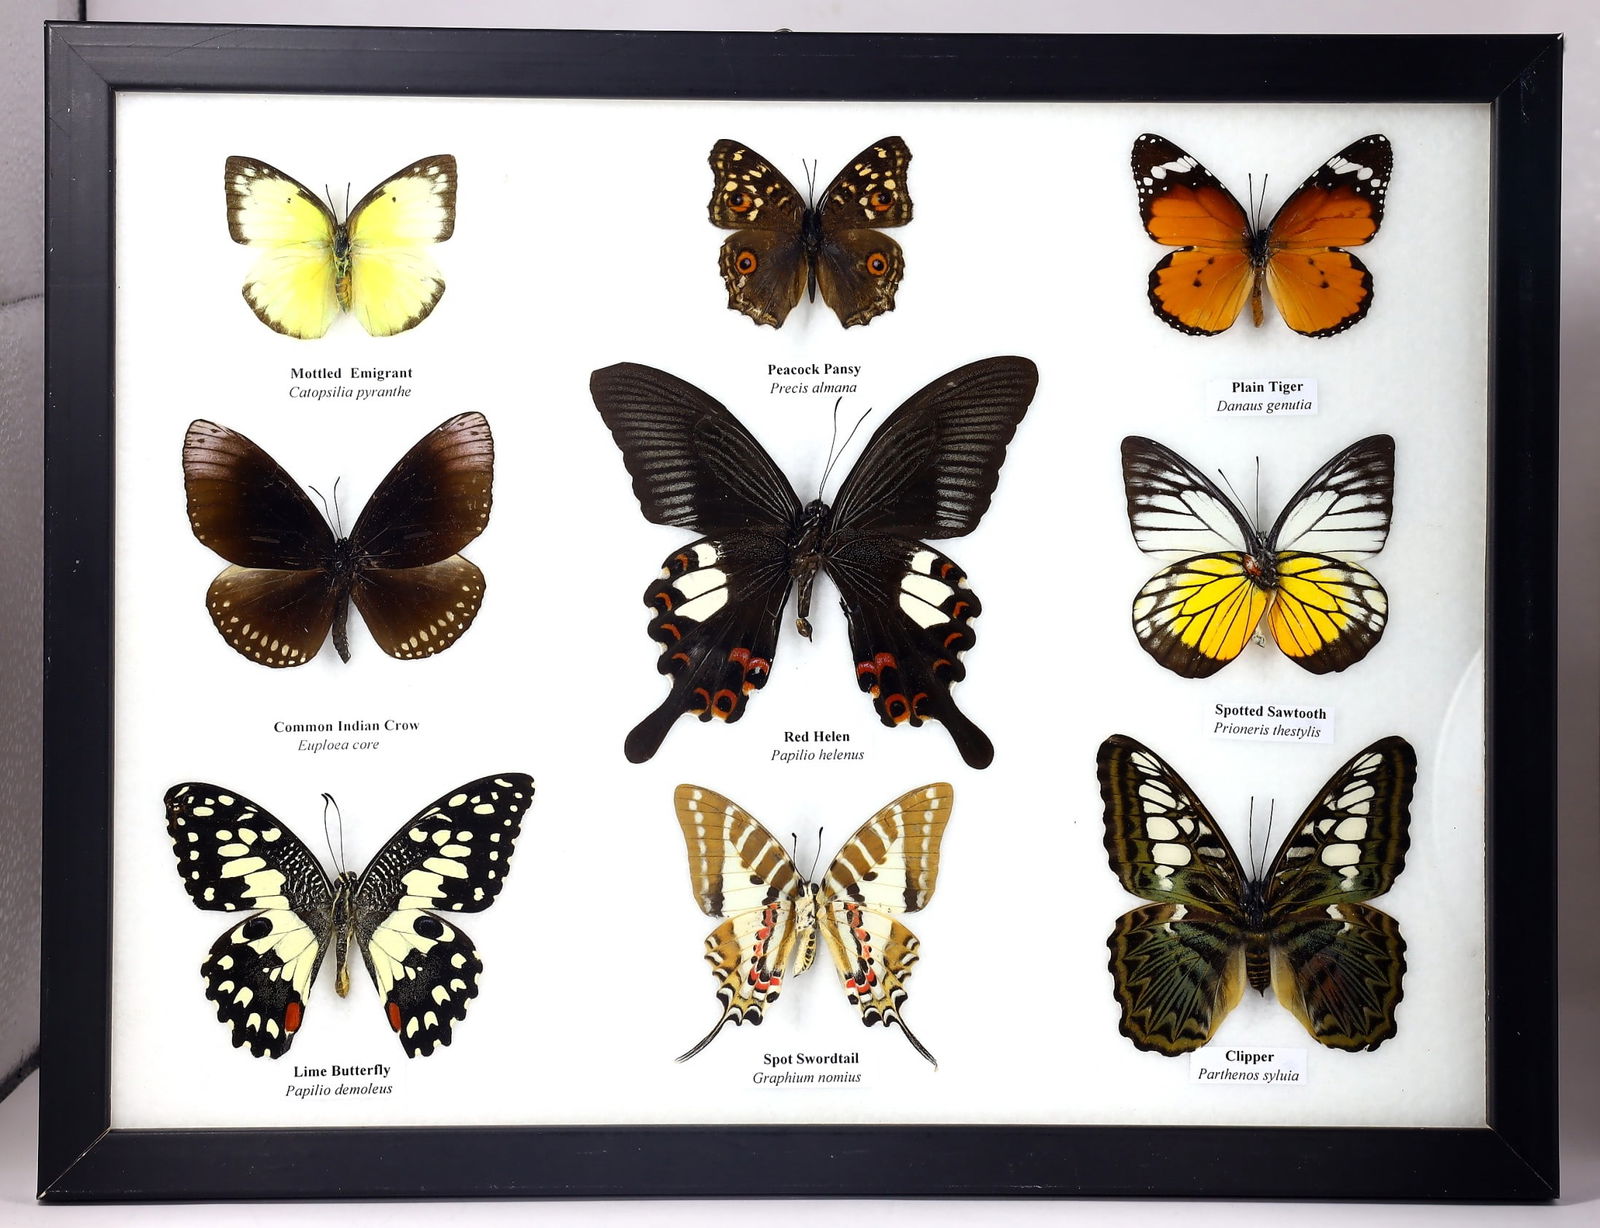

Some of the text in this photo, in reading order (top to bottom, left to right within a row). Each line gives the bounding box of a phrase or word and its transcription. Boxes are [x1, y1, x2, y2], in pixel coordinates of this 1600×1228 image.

[290, 367, 413, 382] Mottled Emigrant
[768, 363, 862, 378] Peacock Pansy
[289, 385, 412, 401] Catopsilia pyranthe
[770, 382, 857, 394] Precis almana
[1232, 380, 1304, 395] Plain Tiger
[1216, 398, 1312, 414] Danaus genutia
[1215, 703, 1327, 720] Spotted Sawtooth
[273, 720, 420, 733] Common Indian Crow
[1213, 721, 1321, 740] Prioneris thestylis
[784, 730, 850, 743] Red Helen
[298, 738, 380, 754] Euploea core
[771, 748, 865, 764] Papilio helenus
[763, 1052, 859, 1068] Spot Swordtail
[1226, 1050, 1274, 1064] Clipper
[294, 1064, 391, 1079] Lime Butterfly
[752, 1071, 861, 1087] Graphium nomius
[1198, 1067, 1260, 1081] Parthenos
[285, 1082, 393, 1100] Papilio demoleus
